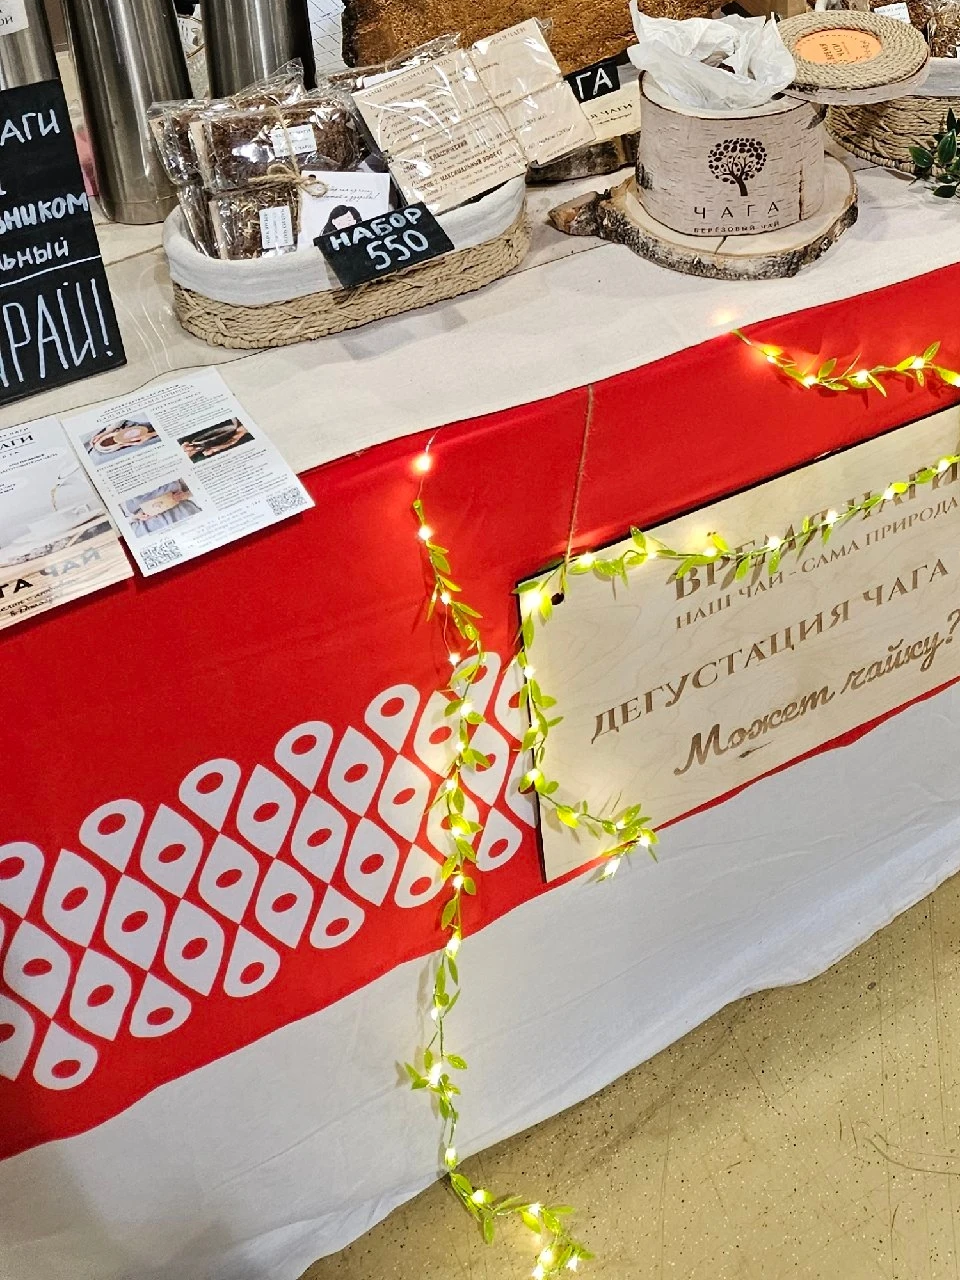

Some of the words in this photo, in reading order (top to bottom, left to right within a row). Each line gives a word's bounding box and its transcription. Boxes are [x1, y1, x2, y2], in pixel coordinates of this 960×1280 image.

[575, 66, 614, 100] ГА
[329, 207, 422, 251] НАБОР
[693, 201, 780, 220] ЧАГА
[693, 223, 757, 234] БЕРЁЗОВЫЙ
[760, 220, 781, 231] ЧАЙ
[0, 237, 69, 272] ЬНЫЙ
[366, 229, 429, 270] 550
[675, 594, 732, 629] НАШ
[801, 540, 861, 574] САМА
[866, 496, 960, 547] ПРИРОДА
[590, 600, 851, 745] ДЕГУСТАЦИЯ
[862, 558, 950, 607] ЧАГА
[673, 689, 837, 776] Может
